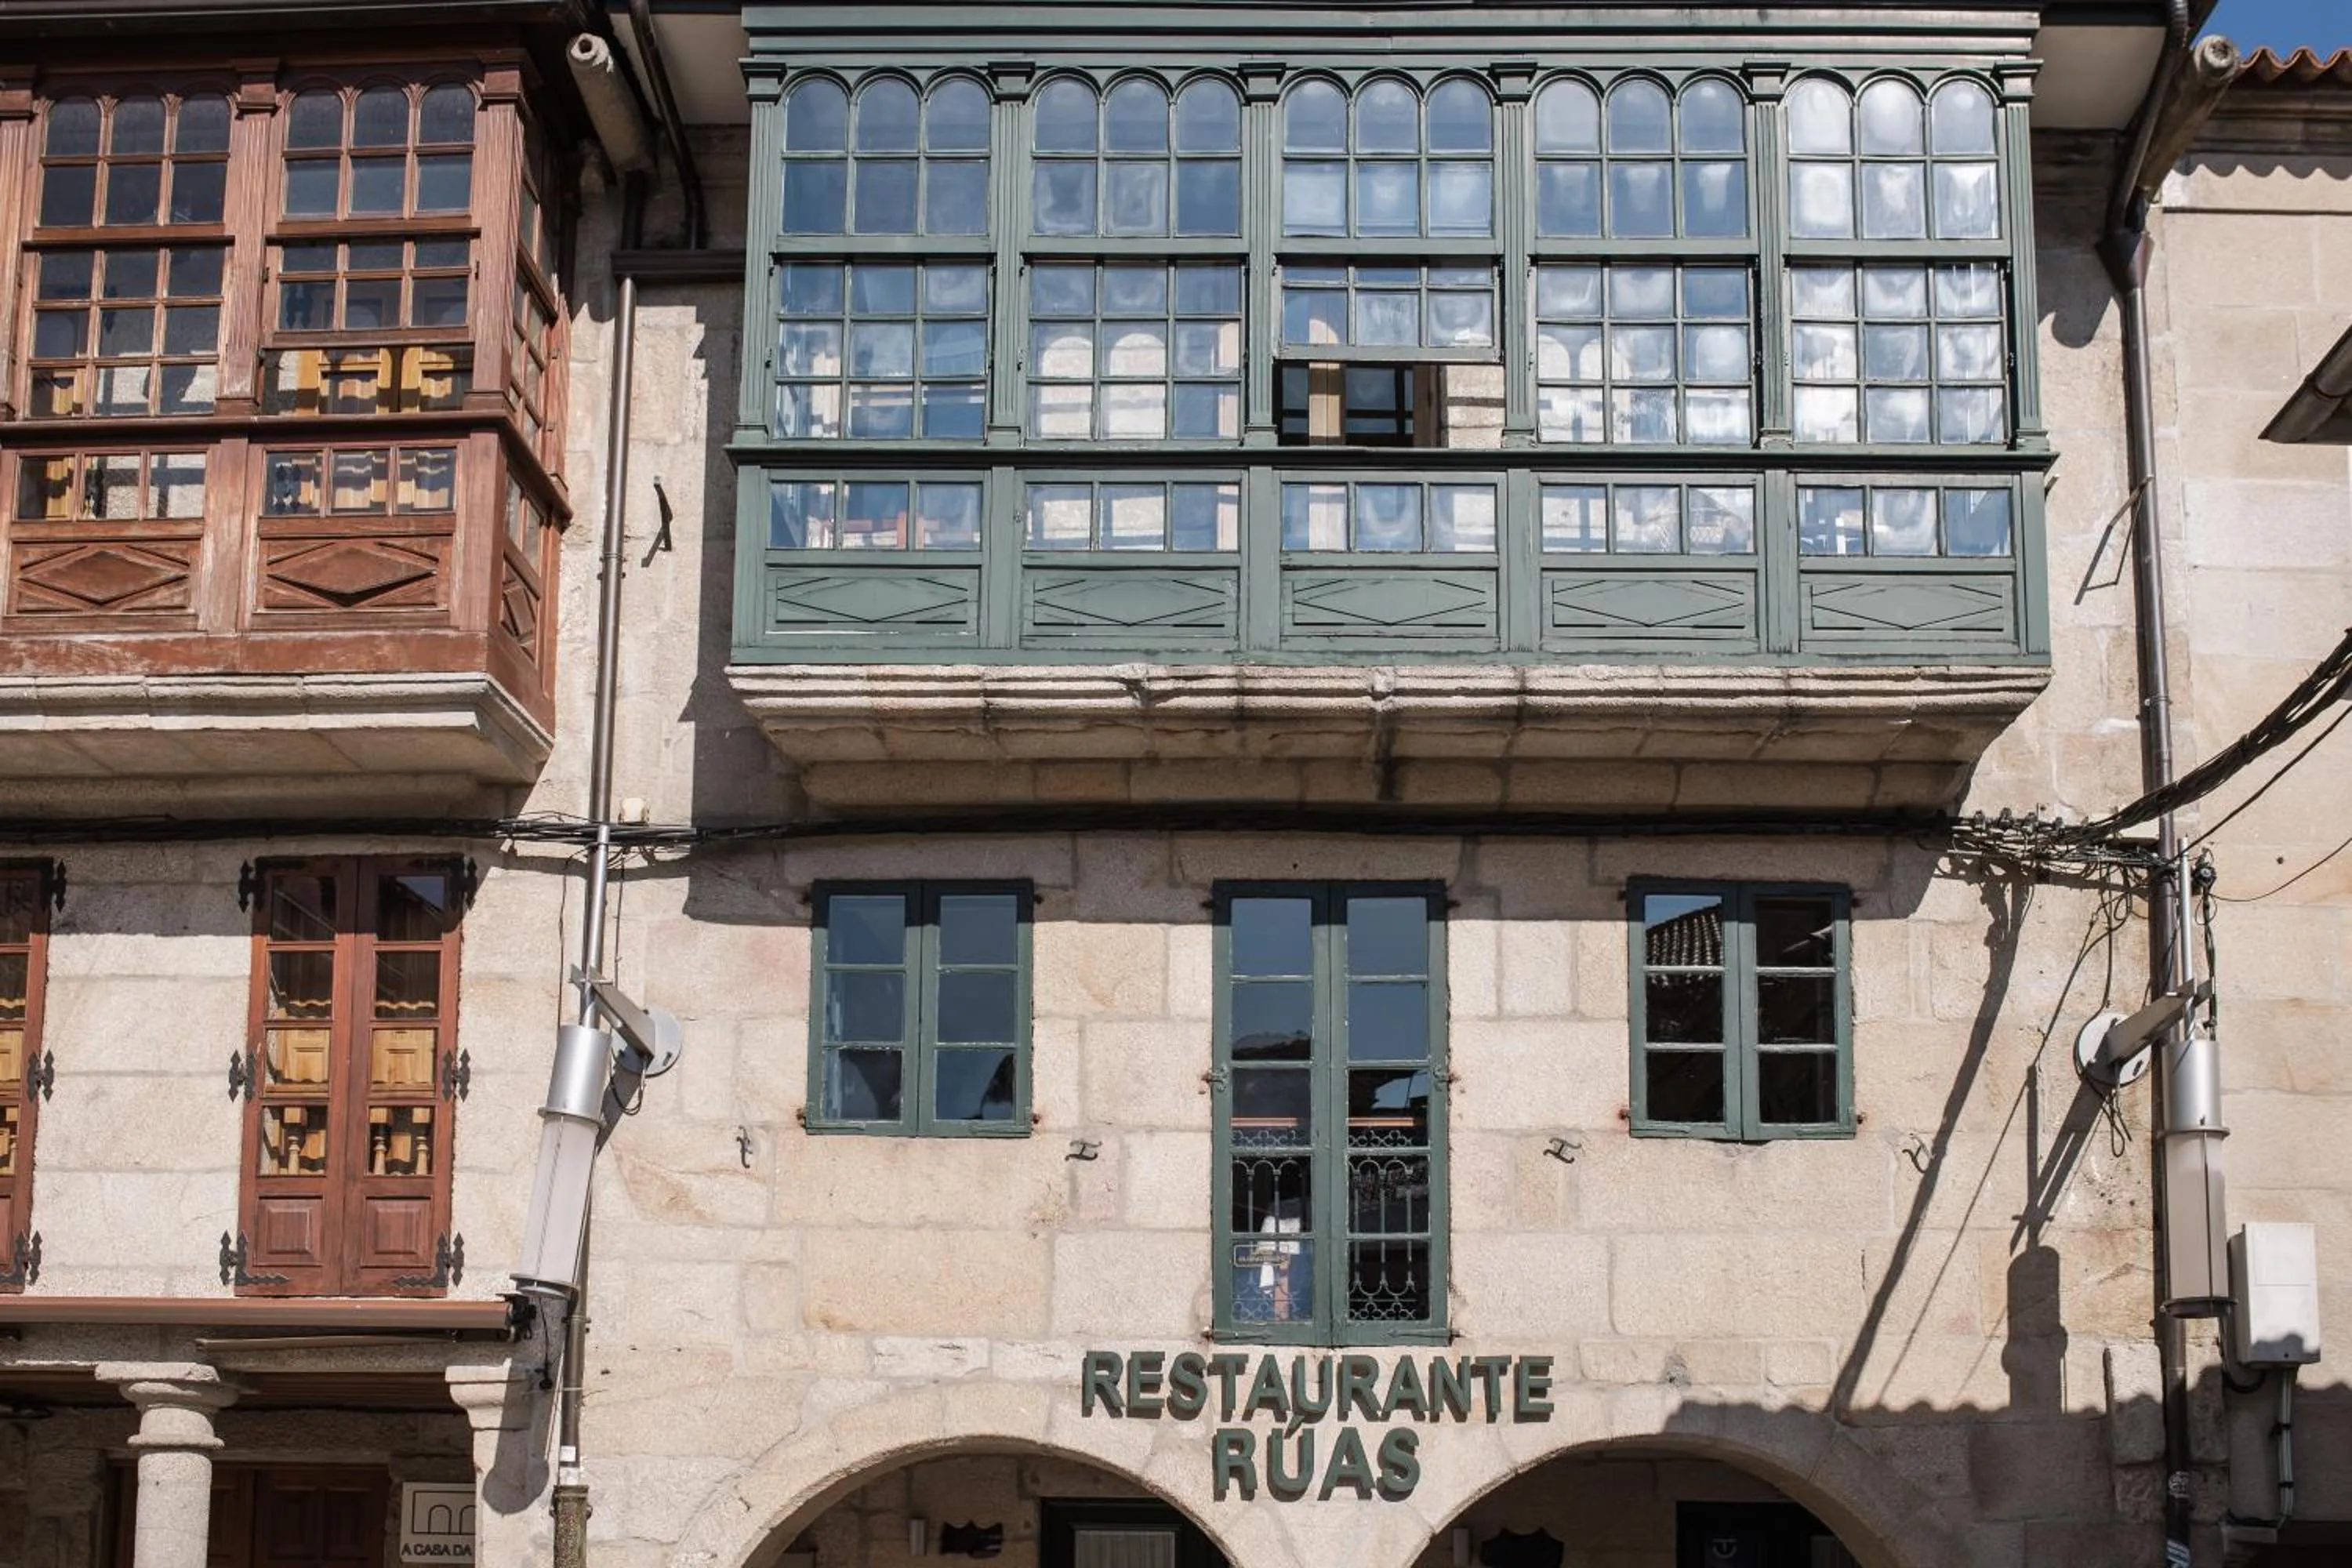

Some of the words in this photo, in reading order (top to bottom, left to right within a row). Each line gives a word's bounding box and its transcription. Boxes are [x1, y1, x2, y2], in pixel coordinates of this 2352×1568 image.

[1083, 1350, 1555, 1416] RESTAURANTE
[1215, 1415, 1421, 1493] RÚAS
[401, 1543, 412, 1555] A
[414, 1543, 451, 1555] CASA
[453, 1543, 472, 1555] DA
